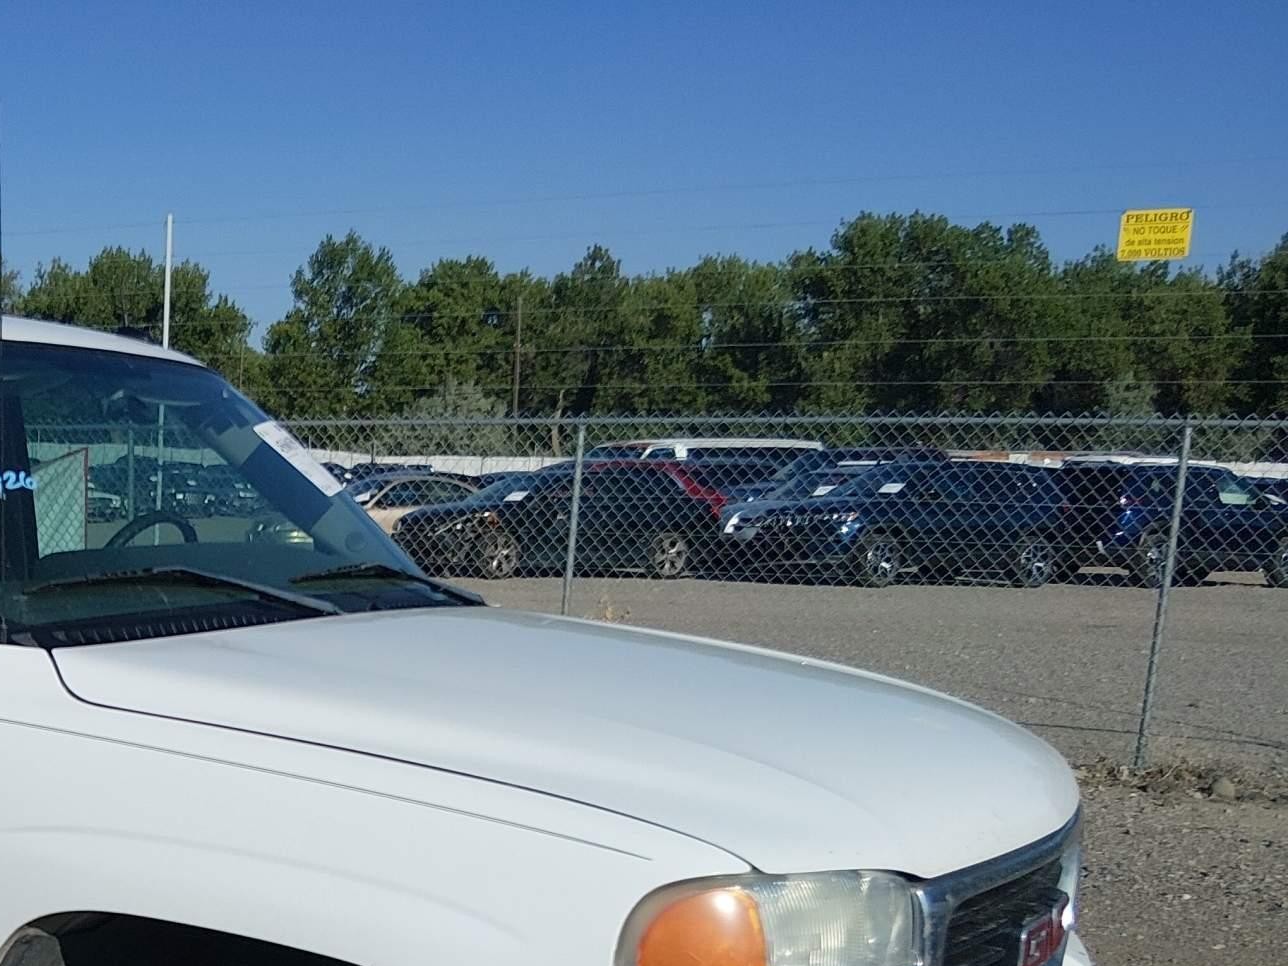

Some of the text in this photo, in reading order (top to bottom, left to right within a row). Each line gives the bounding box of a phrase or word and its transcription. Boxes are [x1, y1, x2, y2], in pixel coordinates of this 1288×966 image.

[1125, 211, 1191, 224] PELIGRO
[1133, 225, 1178, 236] NO TOQUE
[1144, 247, 1186, 257] VOLTIOS
